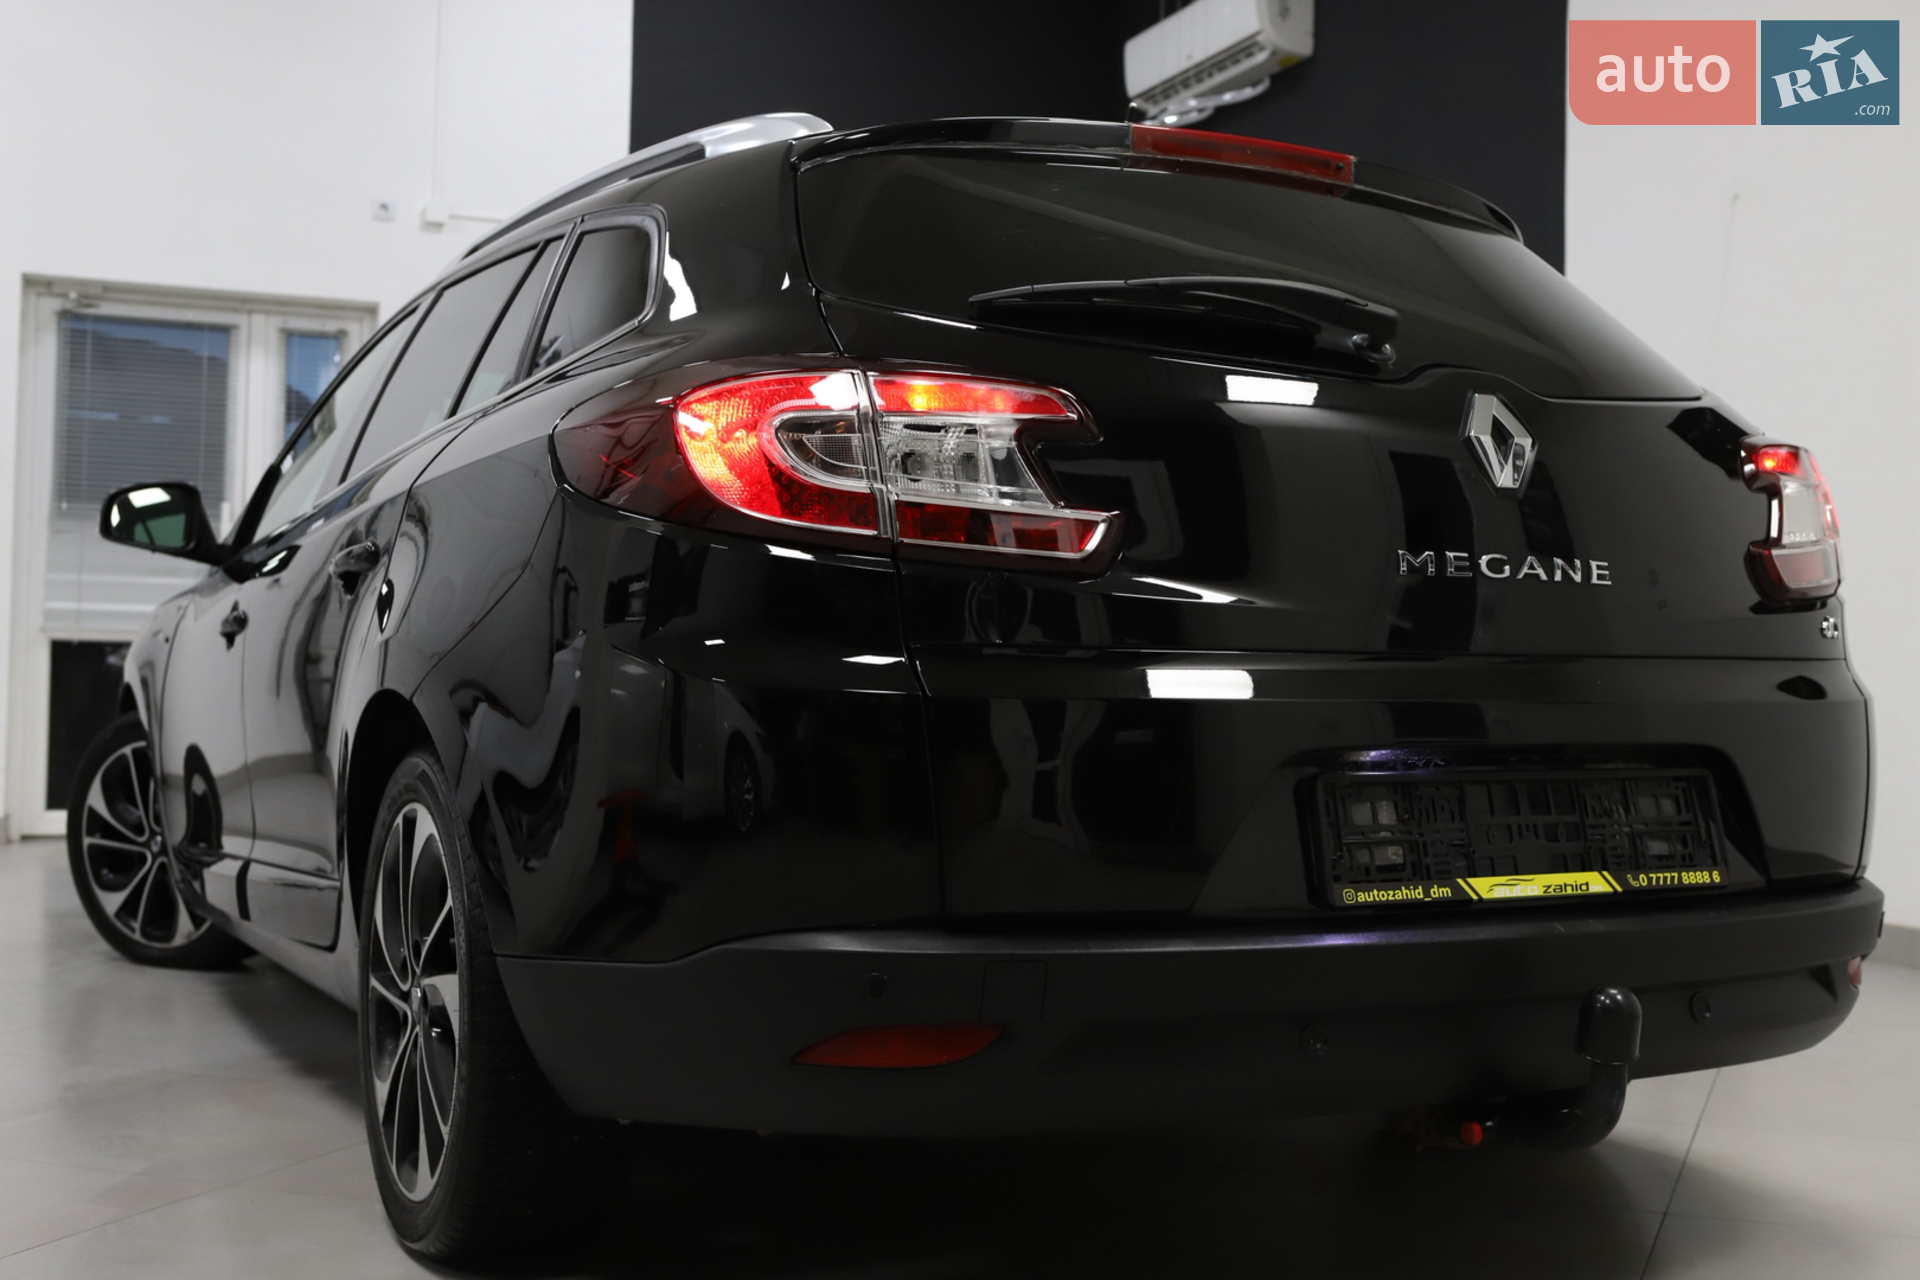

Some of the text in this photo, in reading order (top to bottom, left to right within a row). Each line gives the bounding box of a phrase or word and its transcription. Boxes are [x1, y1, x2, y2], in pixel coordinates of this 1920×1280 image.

[1397, 549, 1612, 585] MEGANE
[1639, 870, 1721, 887] 0 7777 8888 6
[1357, 884, 1452, 902] autozahid_dm
[1542, 881, 1589, 894] zahid
